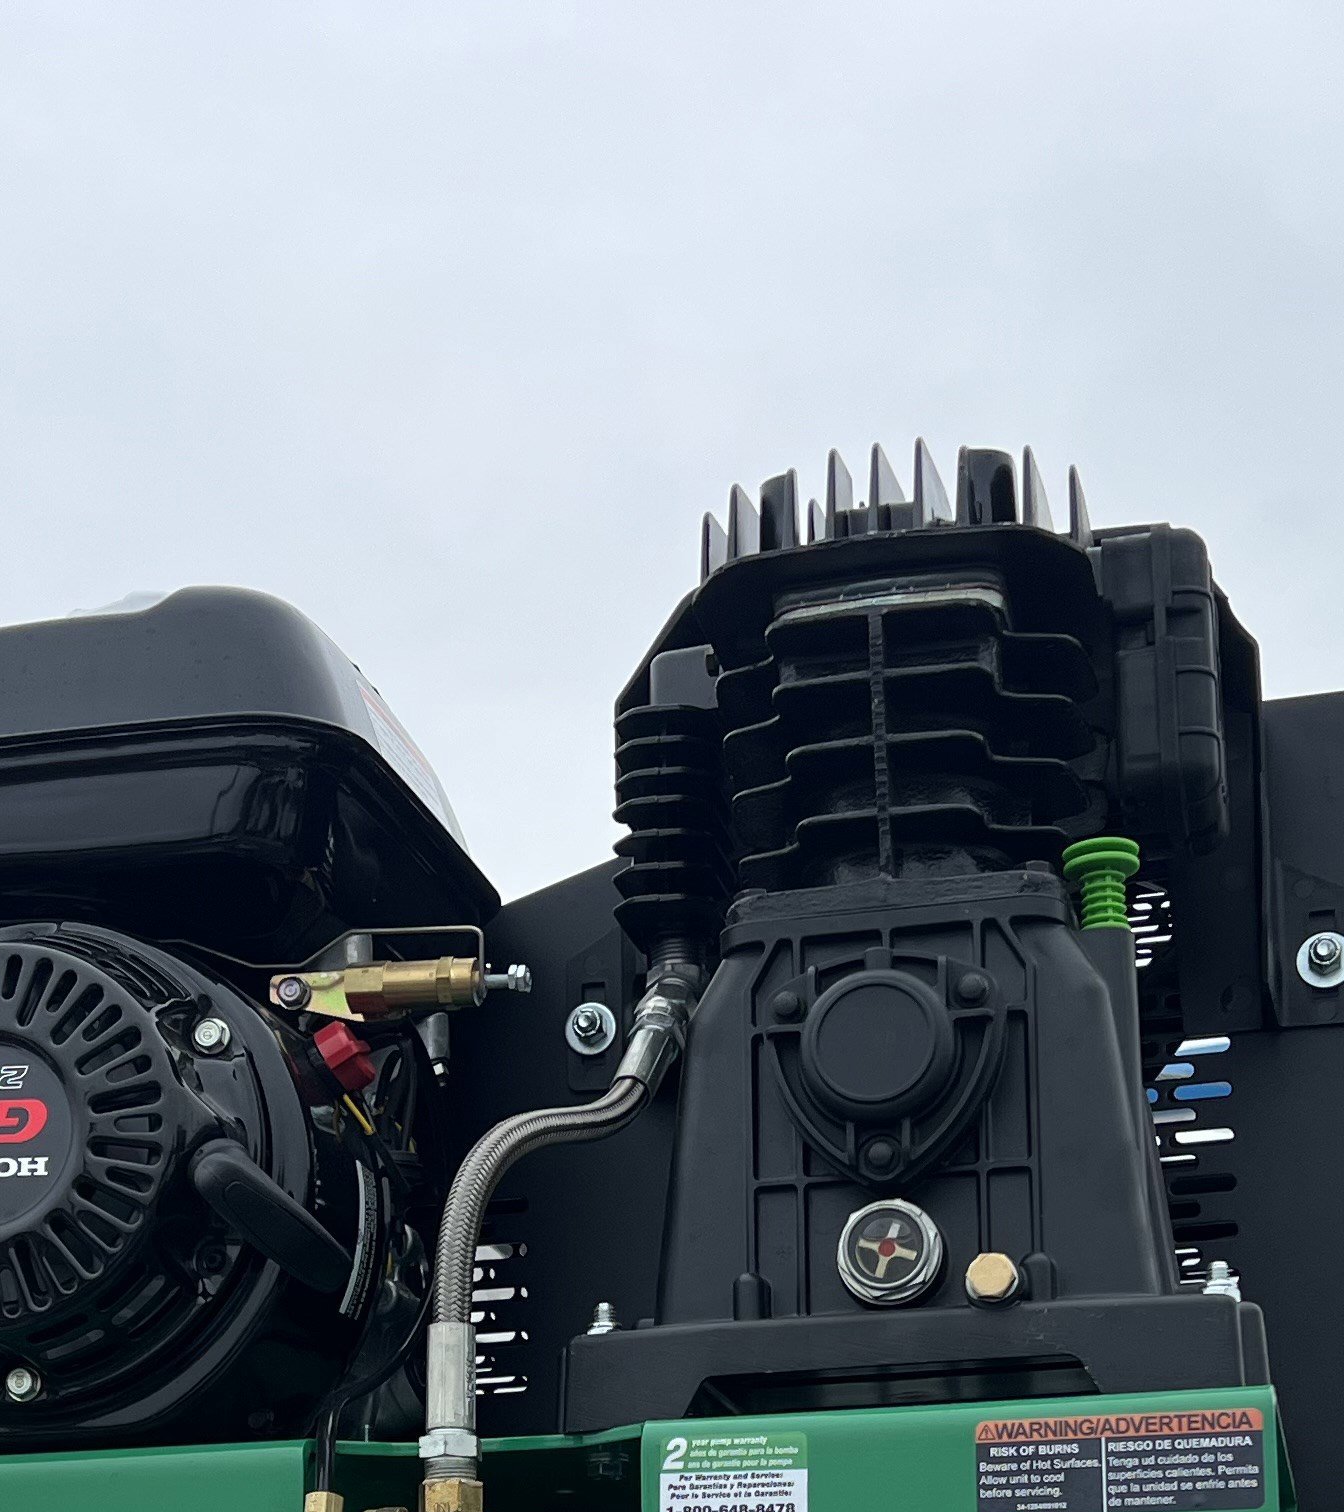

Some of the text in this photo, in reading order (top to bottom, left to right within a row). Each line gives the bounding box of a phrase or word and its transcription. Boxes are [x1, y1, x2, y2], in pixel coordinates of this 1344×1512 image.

[995, 1412, 1253, 1440] WARNING/ADVERTENCIA
[990, 1444, 1079, 1457] RISK OF BURNS
[1108, 1436, 1252, 1451] RIESGO DE QUEMADURA
[662, 1437, 688, 1470] 2
[1107, 1452, 1233, 1468] Tenga ud cuidado de los
[979, 1458, 1102, 1472] Beware of Hot Surfaces.
[1108, 1468, 1163, 1481] superficies
[1218, 1464, 1259, 1475] Permita
[979, 1472, 1064, 1485] Allow unit to cool
[979, 1486, 1062, 1498] before servicing.
[1108, 1485, 1127, 1495] que
[1130, 1483, 1140, 1492] la
[1142, 1481, 1178, 1491] unidad
[1180, 1482, 1193, 1490] se
[1228, 1478, 1258, 1487] antes
[1108, 1495, 1176, 1506] de mantener.
